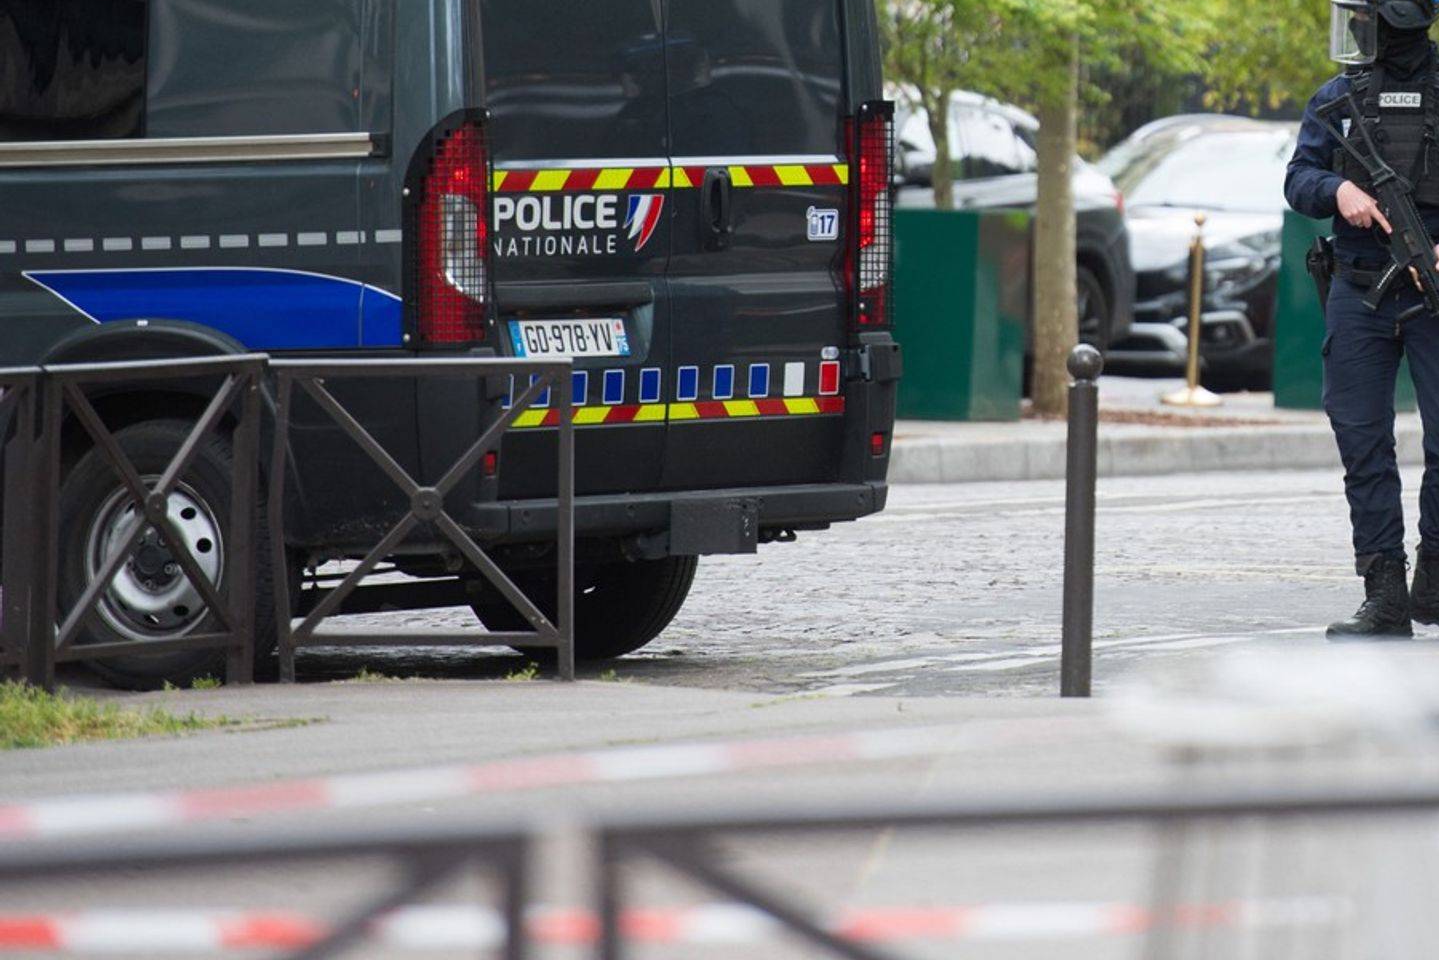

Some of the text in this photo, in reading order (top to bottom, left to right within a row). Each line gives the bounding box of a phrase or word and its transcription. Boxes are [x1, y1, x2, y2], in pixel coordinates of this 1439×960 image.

[493, 194, 618, 232] POLICE
[820, 214, 835, 234] 17
[493, 234, 617, 257] NATIONALE
[524, 323, 612, 354] GD-978-YV
